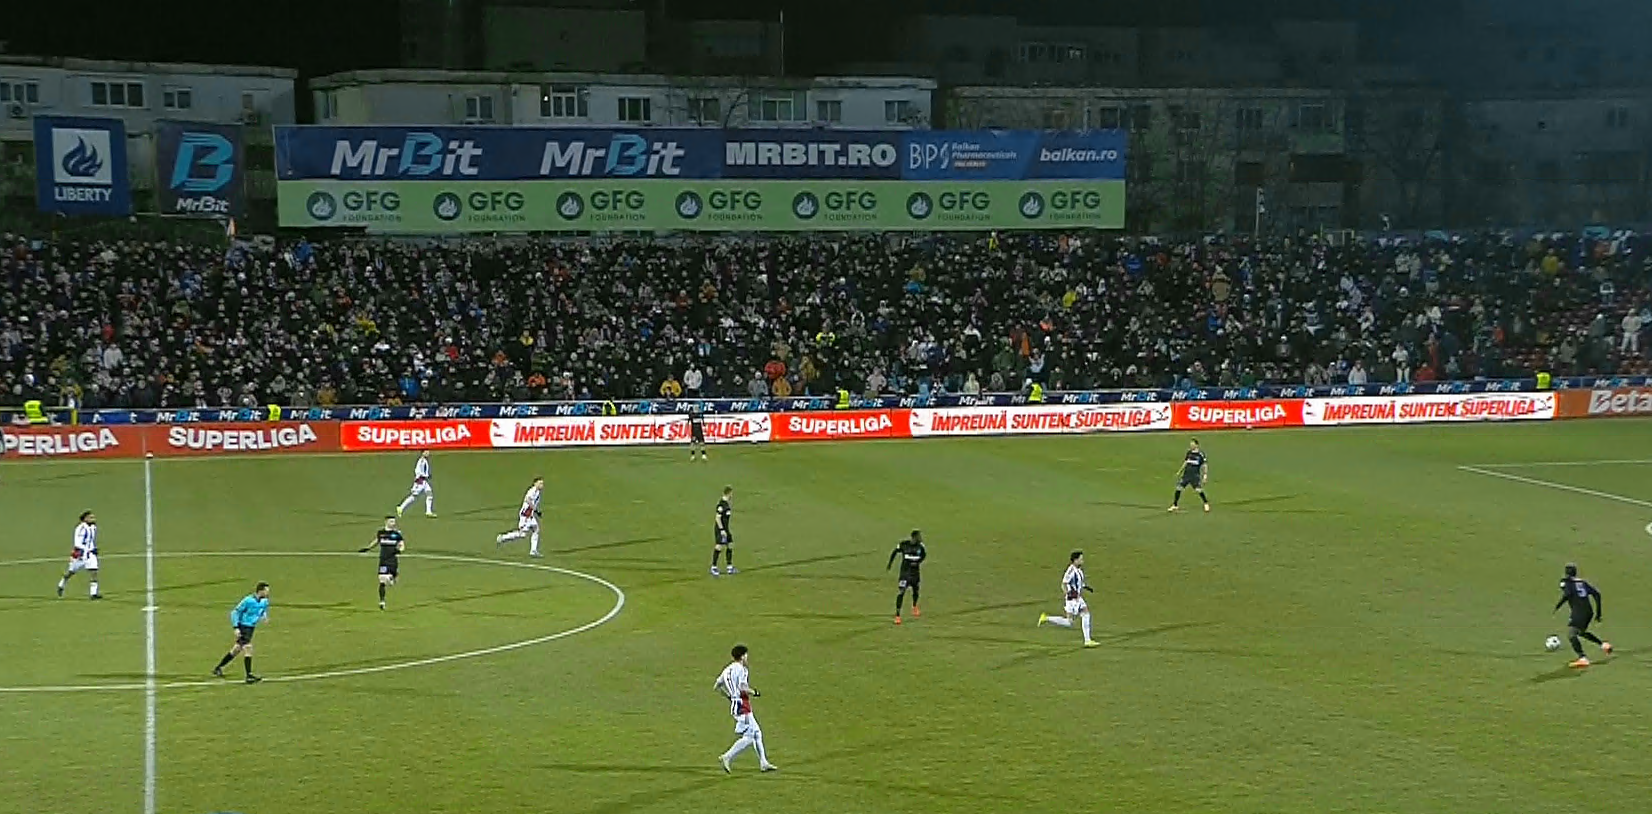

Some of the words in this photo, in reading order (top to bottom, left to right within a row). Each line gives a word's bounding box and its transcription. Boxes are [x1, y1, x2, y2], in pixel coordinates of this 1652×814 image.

[952, 142, 980, 150] Balkan
[330, 132, 483, 176] MrBit
[540, 134, 685, 176] MrBit
[725, 142, 897, 166] MRBIT.RO
[952, 150, 1017, 159] Pharmaceuticals
[1040, 147, 1118, 162] balkan.ro
[54, 187, 112, 202] LIBERTY
[343, 191, 400, 211] GFG
[468, 191, 525, 210] GFG
[590, 190, 644, 210] GFG
[709, 191, 761, 210] GFG
[825, 191, 877, 210] GFG
[939, 191, 990, 210] GFG
[1051, 191, 1100, 210] GFG
[176, 197, 230, 213] MrBit
[1330, 383, 1365, 396] MrBit
[1380, 381, 1415, 395] MrBit
[1436, 381, 1470, 393] MrBit
[1485, 380, 1521, 391] MrBit
[1593, 376, 1629, 388] MrBit
[1062, 392, 1099, 404] MrBit
[1121, 390, 1157, 402] MrBit
[1172, 388, 1208, 400] MrBit
[1223, 387, 1258, 399] MrBit
[1280, 385, 1315, 397] MrBit
[350, 404, 391, 419] MrBit
[500, 402, 539, 417] MrBit
[620, 400, 659, 414] MrBit
[730, 399, 769, 411] MrBit
[792, 398, 829, 410] MrBit
[1323, 401, 1395, 420] ÎMPREUNĂ
[1400, 402, 1456, 417] SUNTEM
[1460, 400, 1536, 417] SUPERLIGA
[156, 409, 200, 422] MrBit
[219, 407, 261, 420] MrBit
[290, 407, 333, 420] MrBit
[931, 411, 1007, 431] ÎMPREUNĂ
[1011, 413, 1071, 428] SUNTEM
[1074, 410, 1151, 427] SUPERLIGA
[1187, 404, 1286, 424] SUPERLIGA
[788, 414, 892, 434] SUPERLIGA
[168, 423, 317, 450] SUPERLIGA
[357, 423, 471, 445] SUPERLIGA
[514, 421, 595, 443] ÎMPREUNĂ
[600, 423, 663, 440] SUNTEM
[1575, 581, 1588, 598] 5
